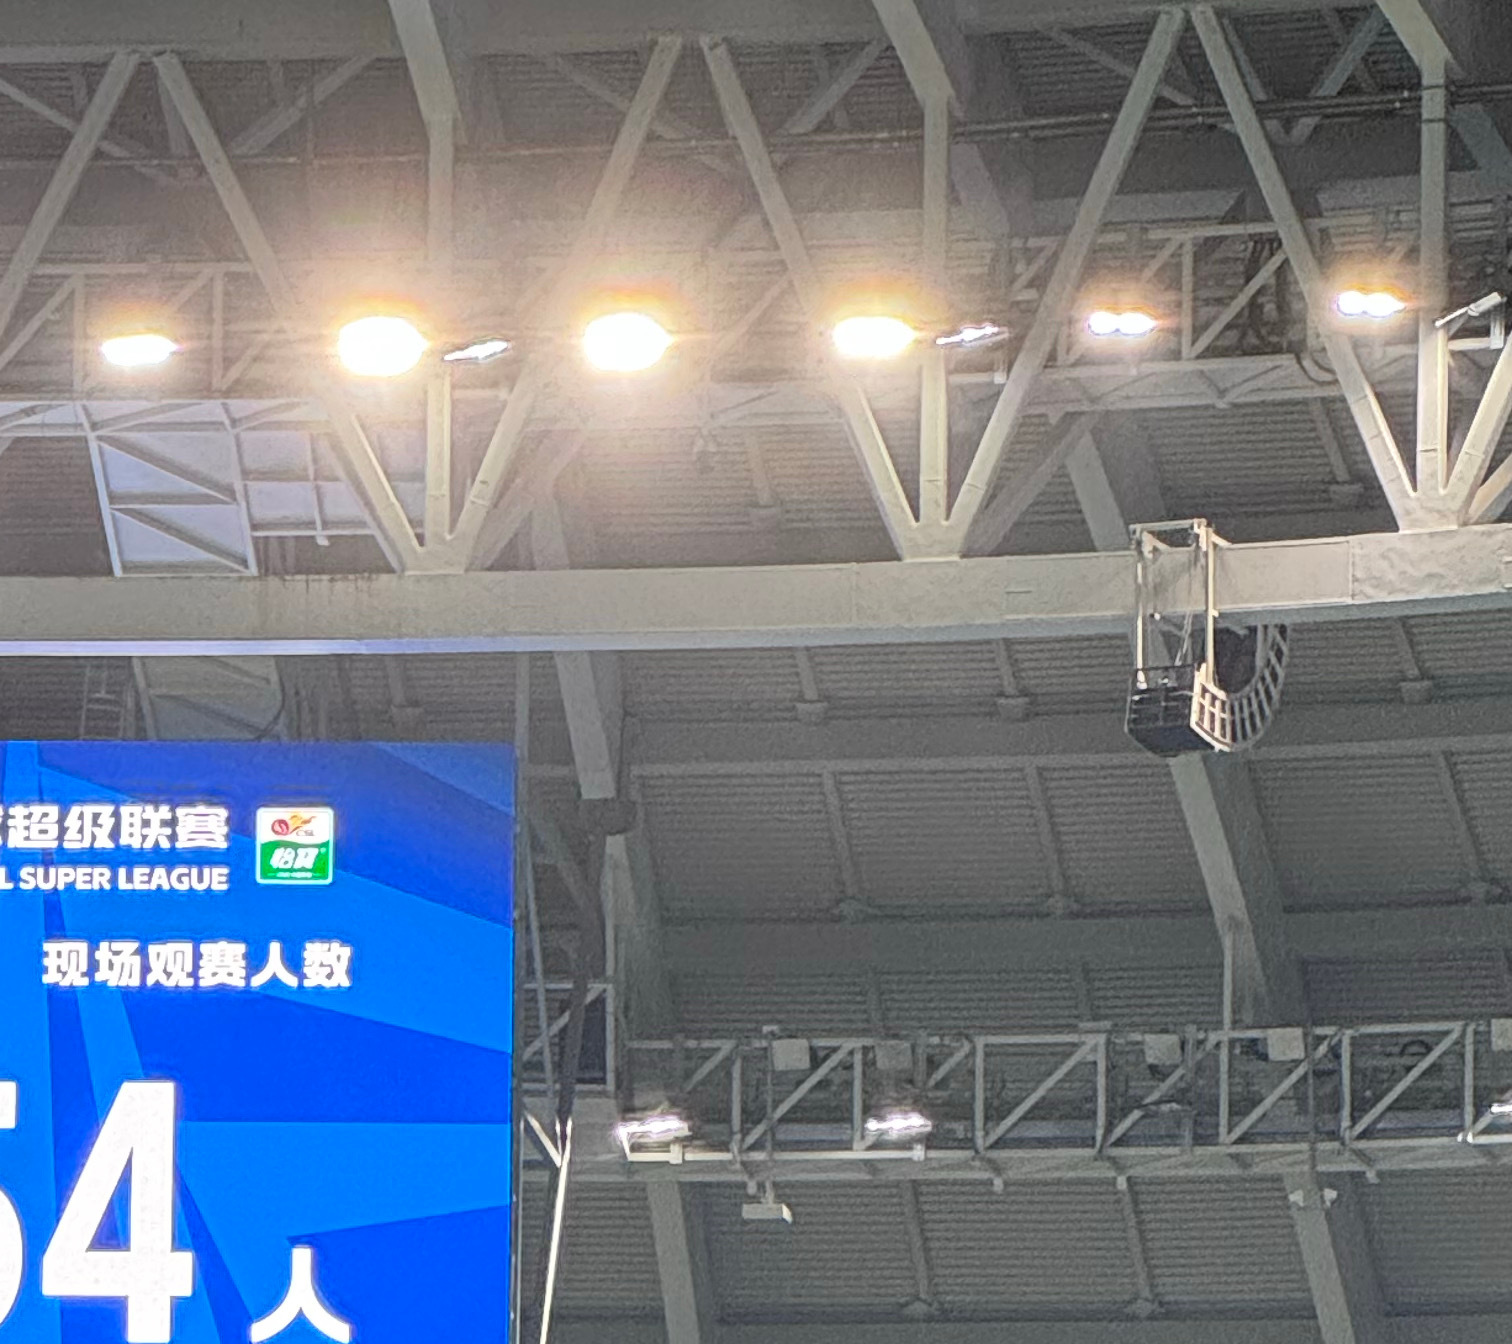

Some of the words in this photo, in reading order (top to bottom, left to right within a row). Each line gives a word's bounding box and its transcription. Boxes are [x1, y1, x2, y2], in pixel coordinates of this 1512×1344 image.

[19, 866, 111, 891] SUPER
[118, 867, 230, 891] LEAGUE
[42, 940, 352, 987] 现场观赛人数
[251, 1246, 351, 1344] 人
